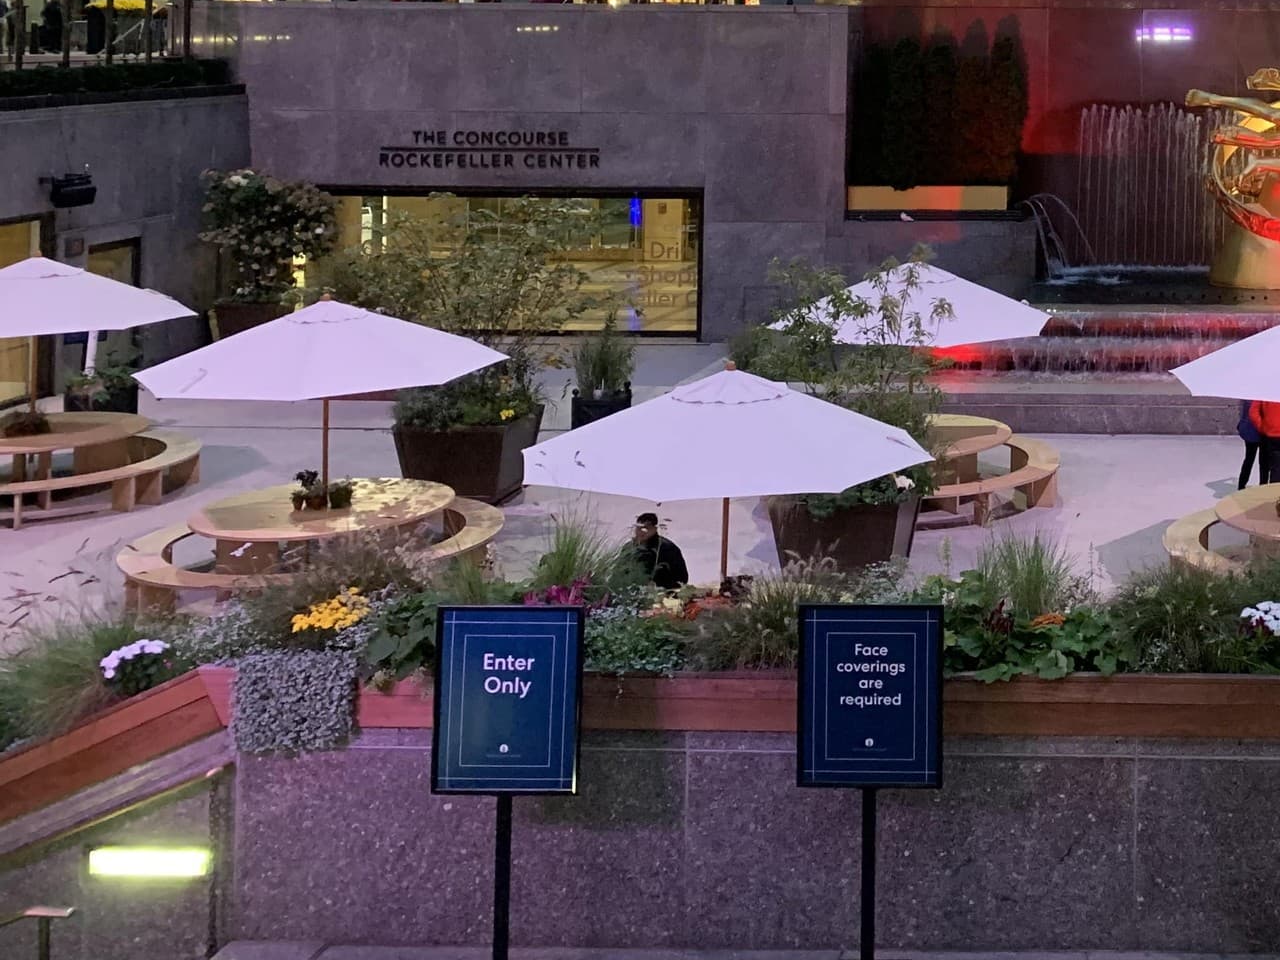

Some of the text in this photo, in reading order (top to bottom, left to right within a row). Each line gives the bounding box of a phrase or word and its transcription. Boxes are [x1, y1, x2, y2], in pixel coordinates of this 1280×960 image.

[412, 131, 569, 146] THE CONCOURSE
[379, 152, 600, 169] ROCKEFELLER CENTER
[854, 643, 888, 656] Face
[483, 652, 536, 671] Enter
[836, 660, 906, 676] coverings
[484, 675, 532, 698] Only
[858, 678, 883, 689] are
[840, 692, 902, 709] required
